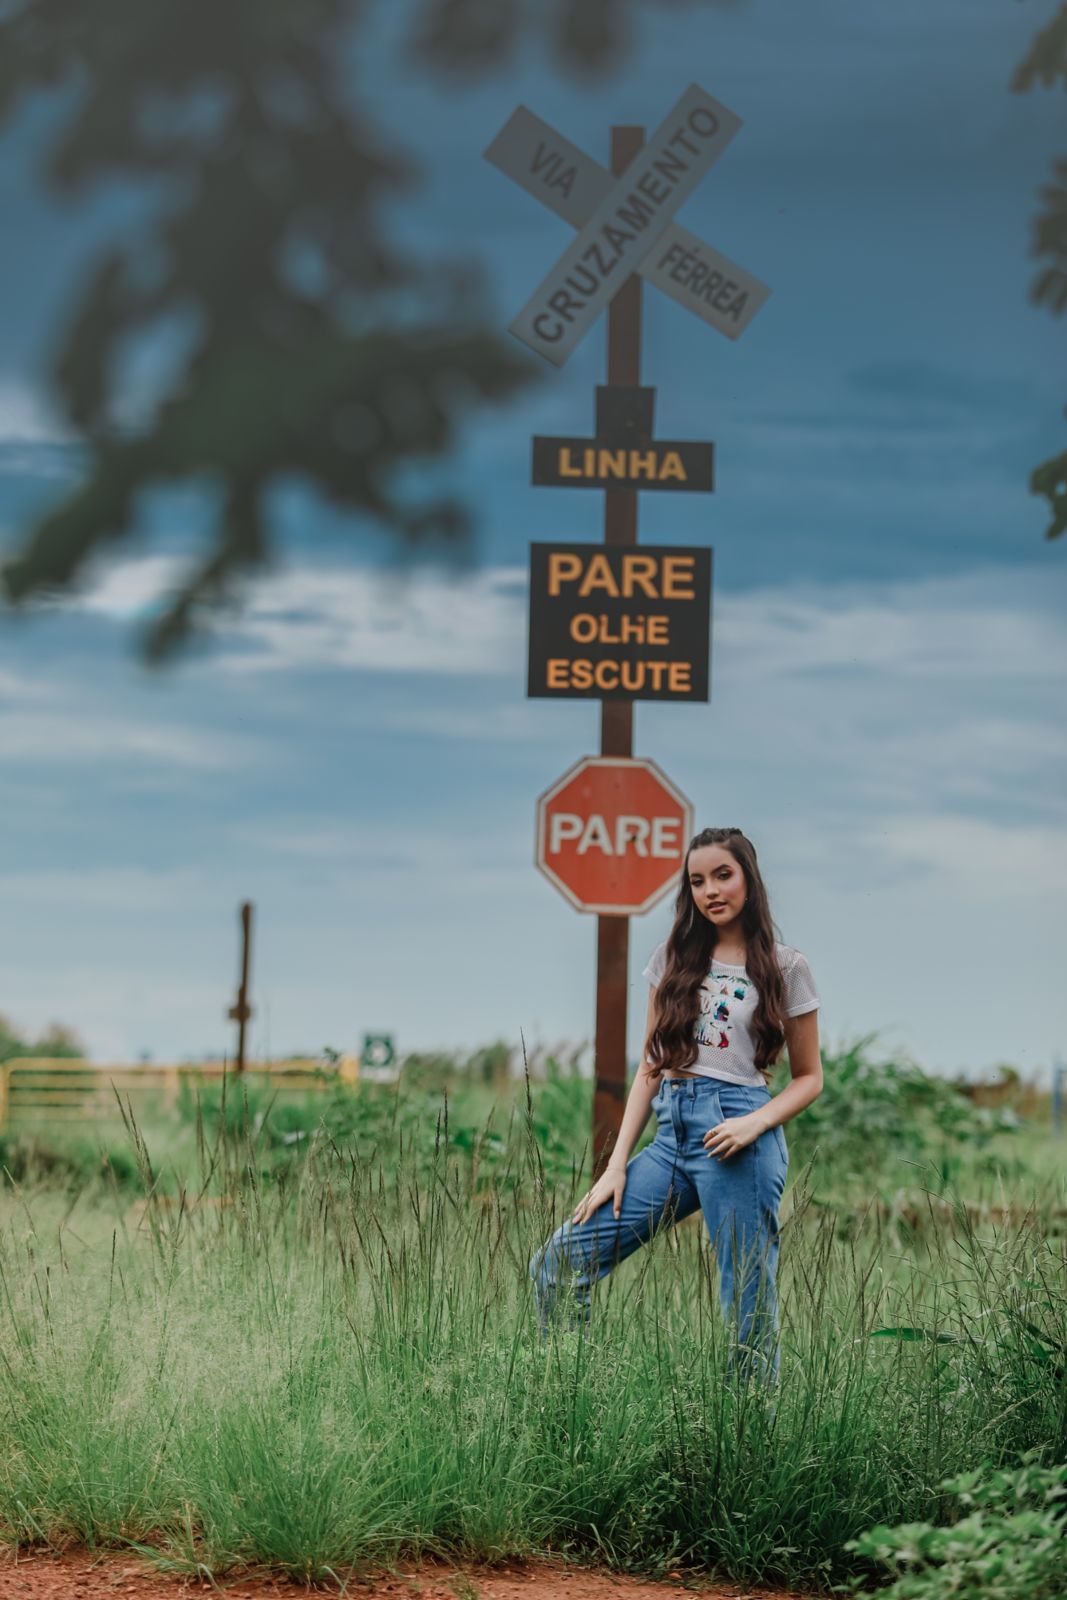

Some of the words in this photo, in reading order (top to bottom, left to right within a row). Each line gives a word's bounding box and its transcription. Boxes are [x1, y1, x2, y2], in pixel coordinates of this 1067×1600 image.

[531, 142, 578, 198] VIA
[532, 107, 719, 344] CRUZAMENTO
[658, 244, 749, 322] FÉRREA
[559, 448, 687, 481] LINHA
[548, 553, 695, 599] PARE
[570, 613, 670, 645] OLHE
[546, 658, 691, 692] ESCUTE
[549, 813, 681, 859] PARE
